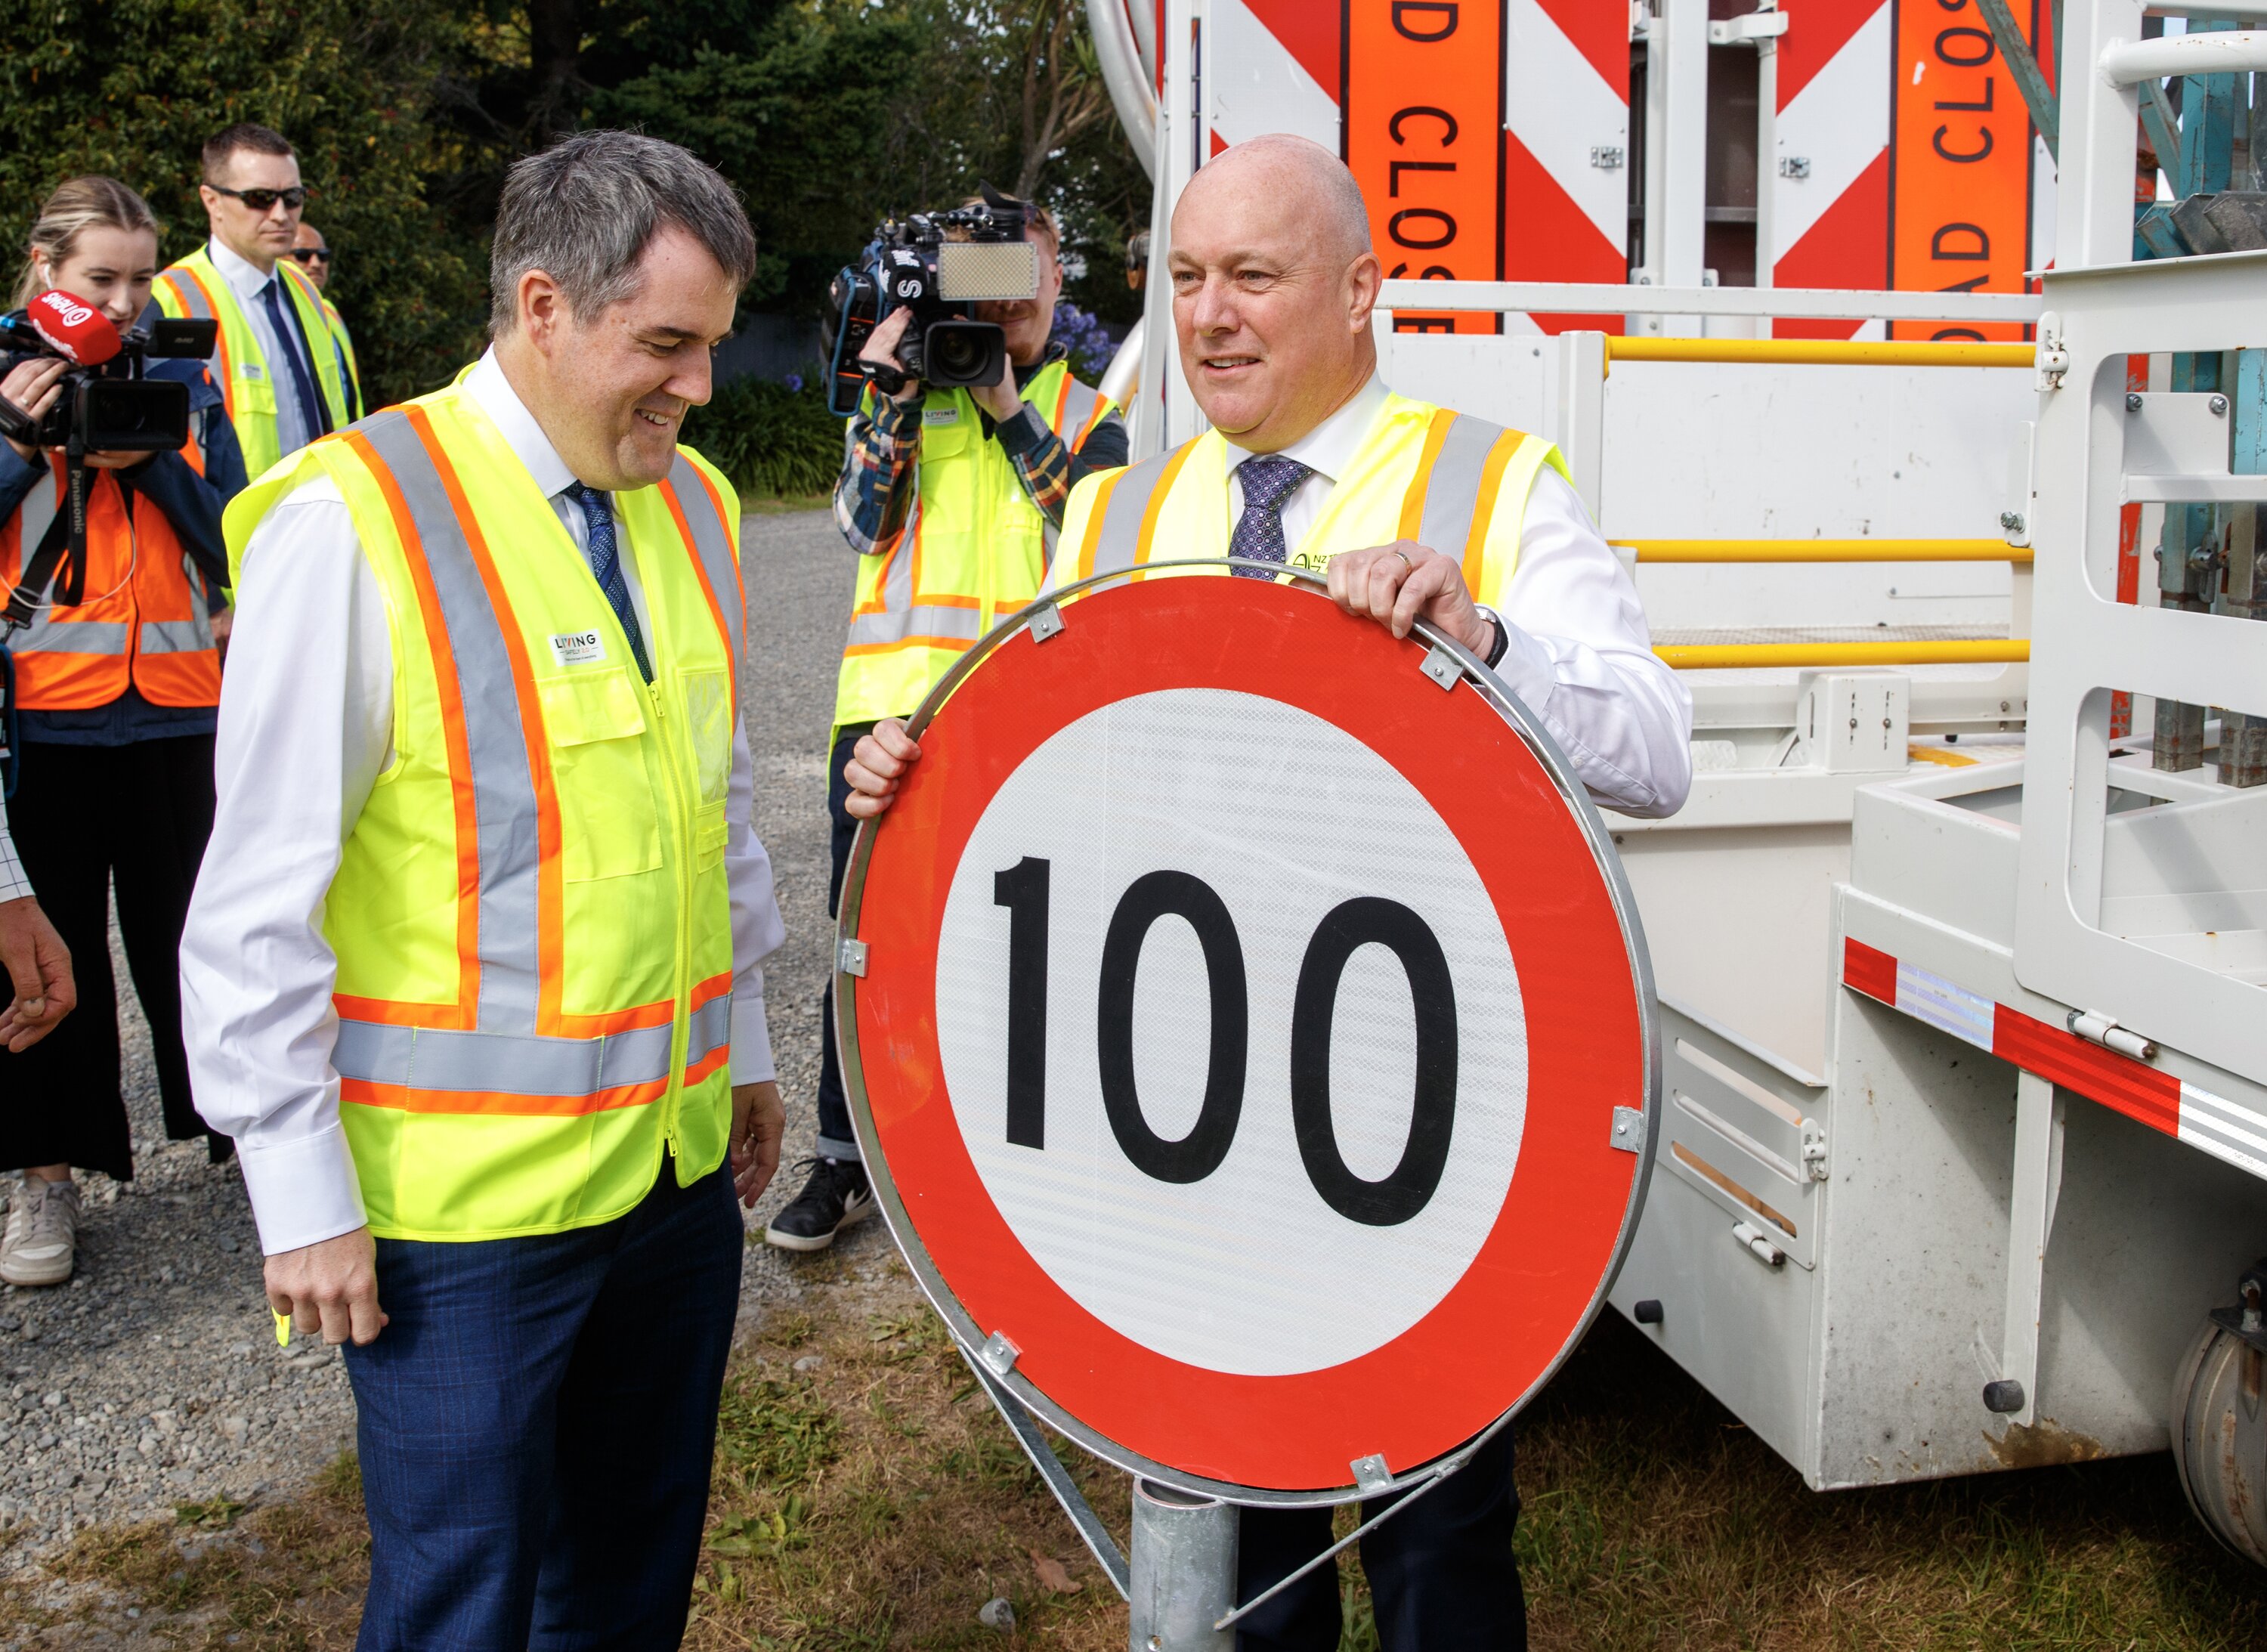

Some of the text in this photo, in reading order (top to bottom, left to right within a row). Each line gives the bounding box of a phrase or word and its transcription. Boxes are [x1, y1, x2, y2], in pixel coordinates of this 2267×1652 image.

[1932, 0, 1994, 163] CLO
[71, 470, 85, 534] Panasonic
[1313, 555, 1327, 563] NZ
[555, 634, 595, 648] LIVING
[994, 856, 1458, 1227] 100
